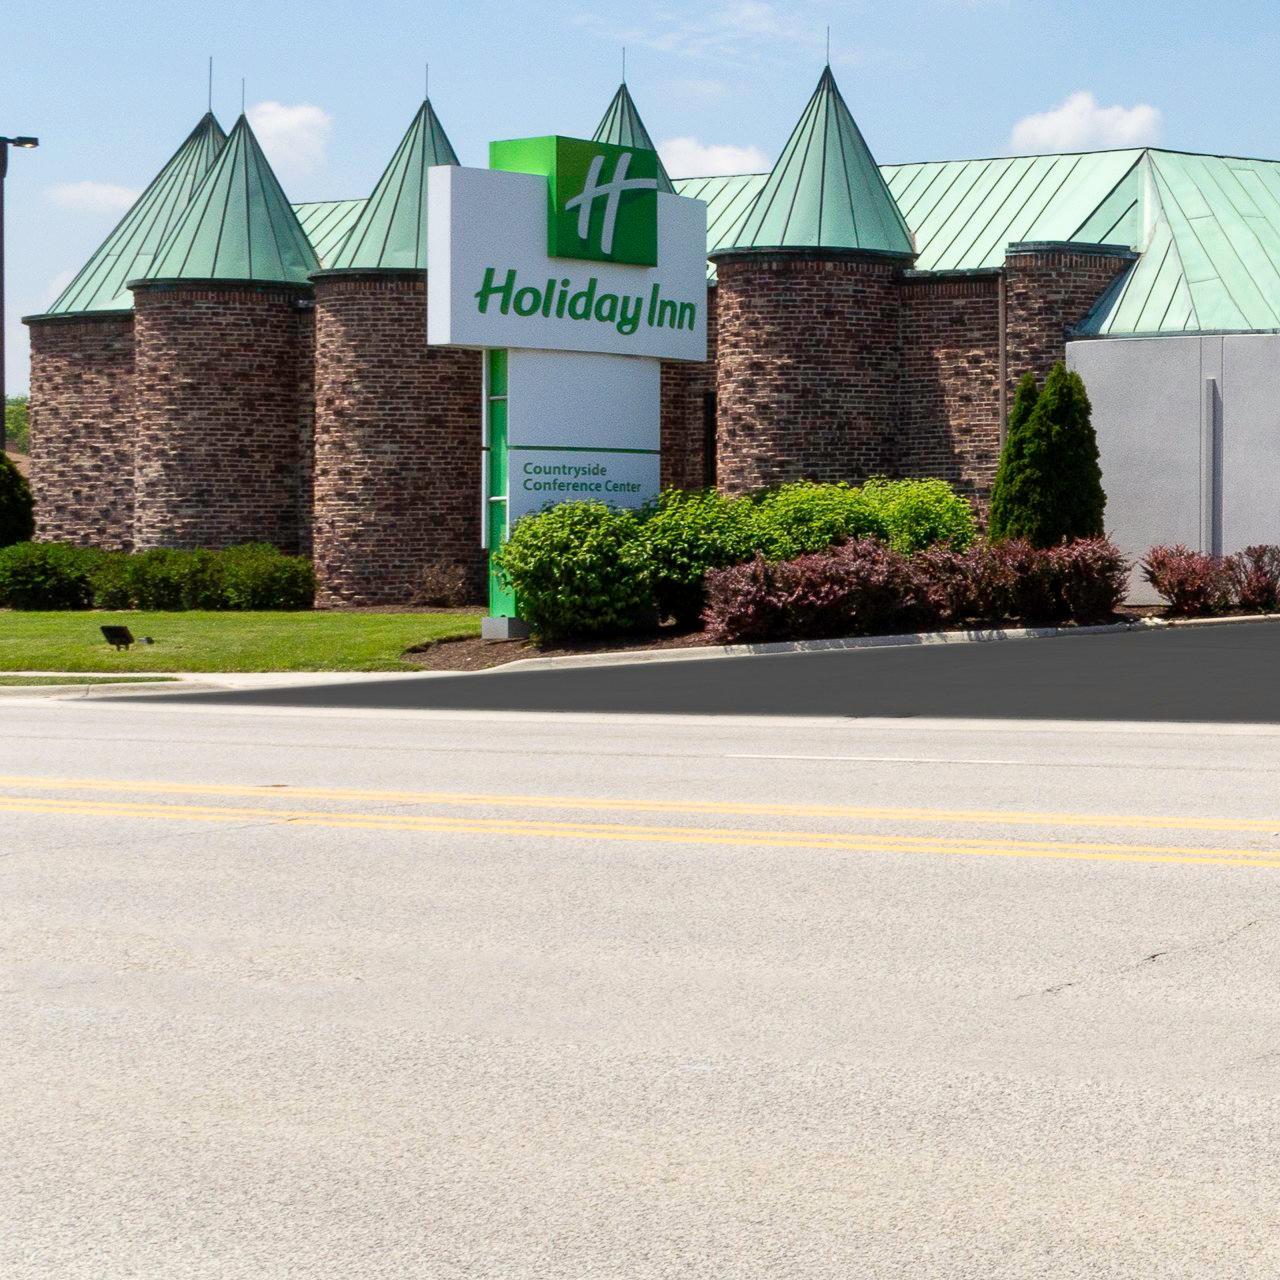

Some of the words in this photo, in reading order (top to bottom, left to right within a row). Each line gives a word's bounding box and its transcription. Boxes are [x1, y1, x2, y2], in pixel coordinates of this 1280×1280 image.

[475, 268, 643, 335] Holiday
[648, 283, 696, 331] Inn
[523, 462, 607, 478] Countryside
[523, 478, 602, 492] Conference
[605, 480, 641, 493] Center
